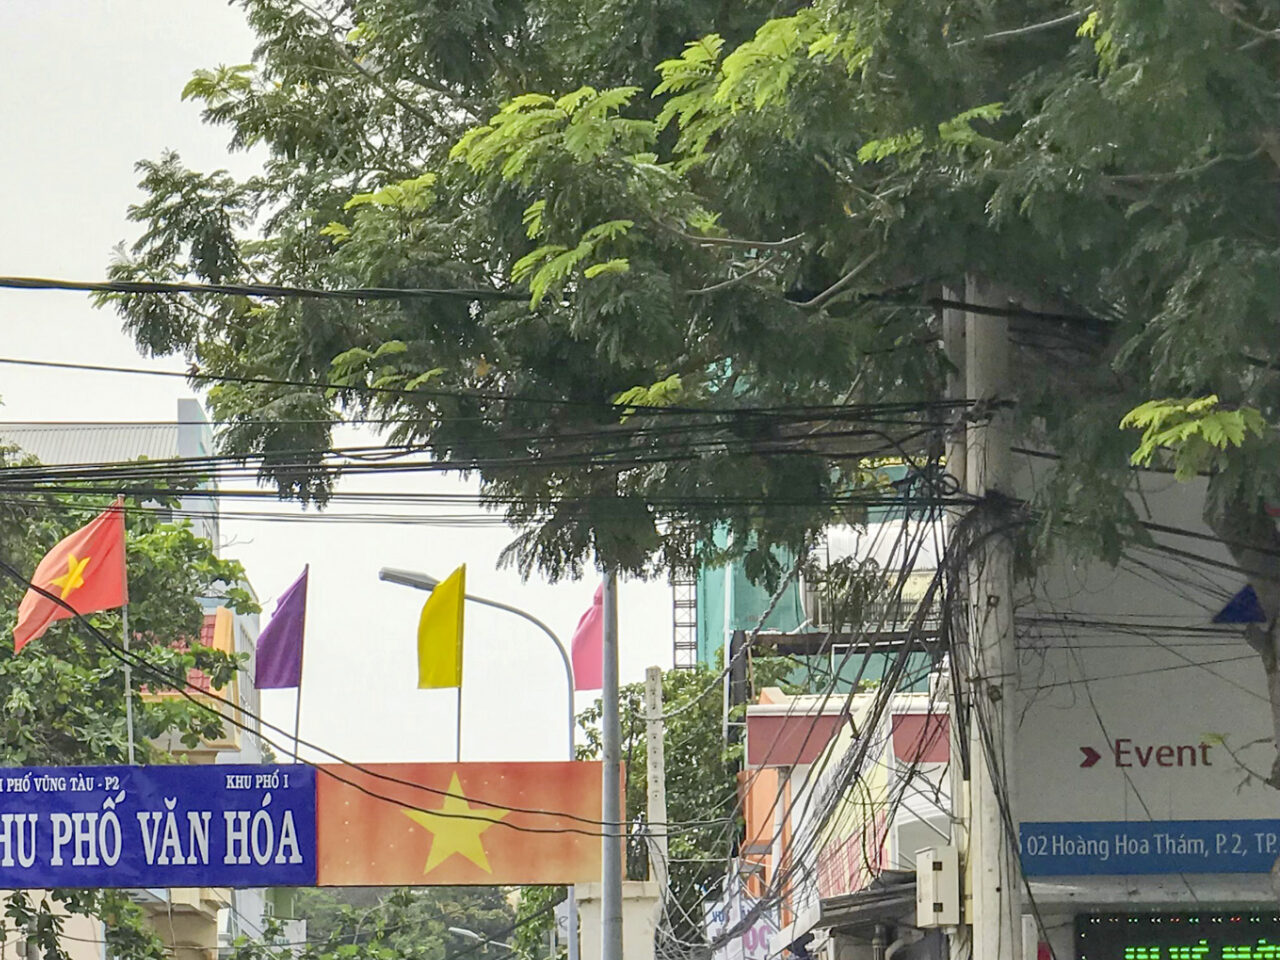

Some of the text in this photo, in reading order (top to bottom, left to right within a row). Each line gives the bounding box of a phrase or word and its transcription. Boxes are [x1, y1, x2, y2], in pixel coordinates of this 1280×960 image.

[1115, 738, 1213, 768] Event
[7, 772, 32, 791] PHỐ
[34, 775, 66, 791] VŨNG
[70, 774, 94, 791] TÀU
[105, 777, 119, 791] P2
[226, 775, 252, 788] KHU
[255, 770, 279, 789] PHỐ
[50, 790, 126, 866] PHỐ
[136, 796, 211, 866] VĂN
[223, 792, 303, 866] HÓA
[1027, 836, 1048, 855] 02
[1052, 835, 1109, 860] Hoàng
[1115, 834, 1149, 855] Hoa
[1153, 833, 1209, 858] Thám,
